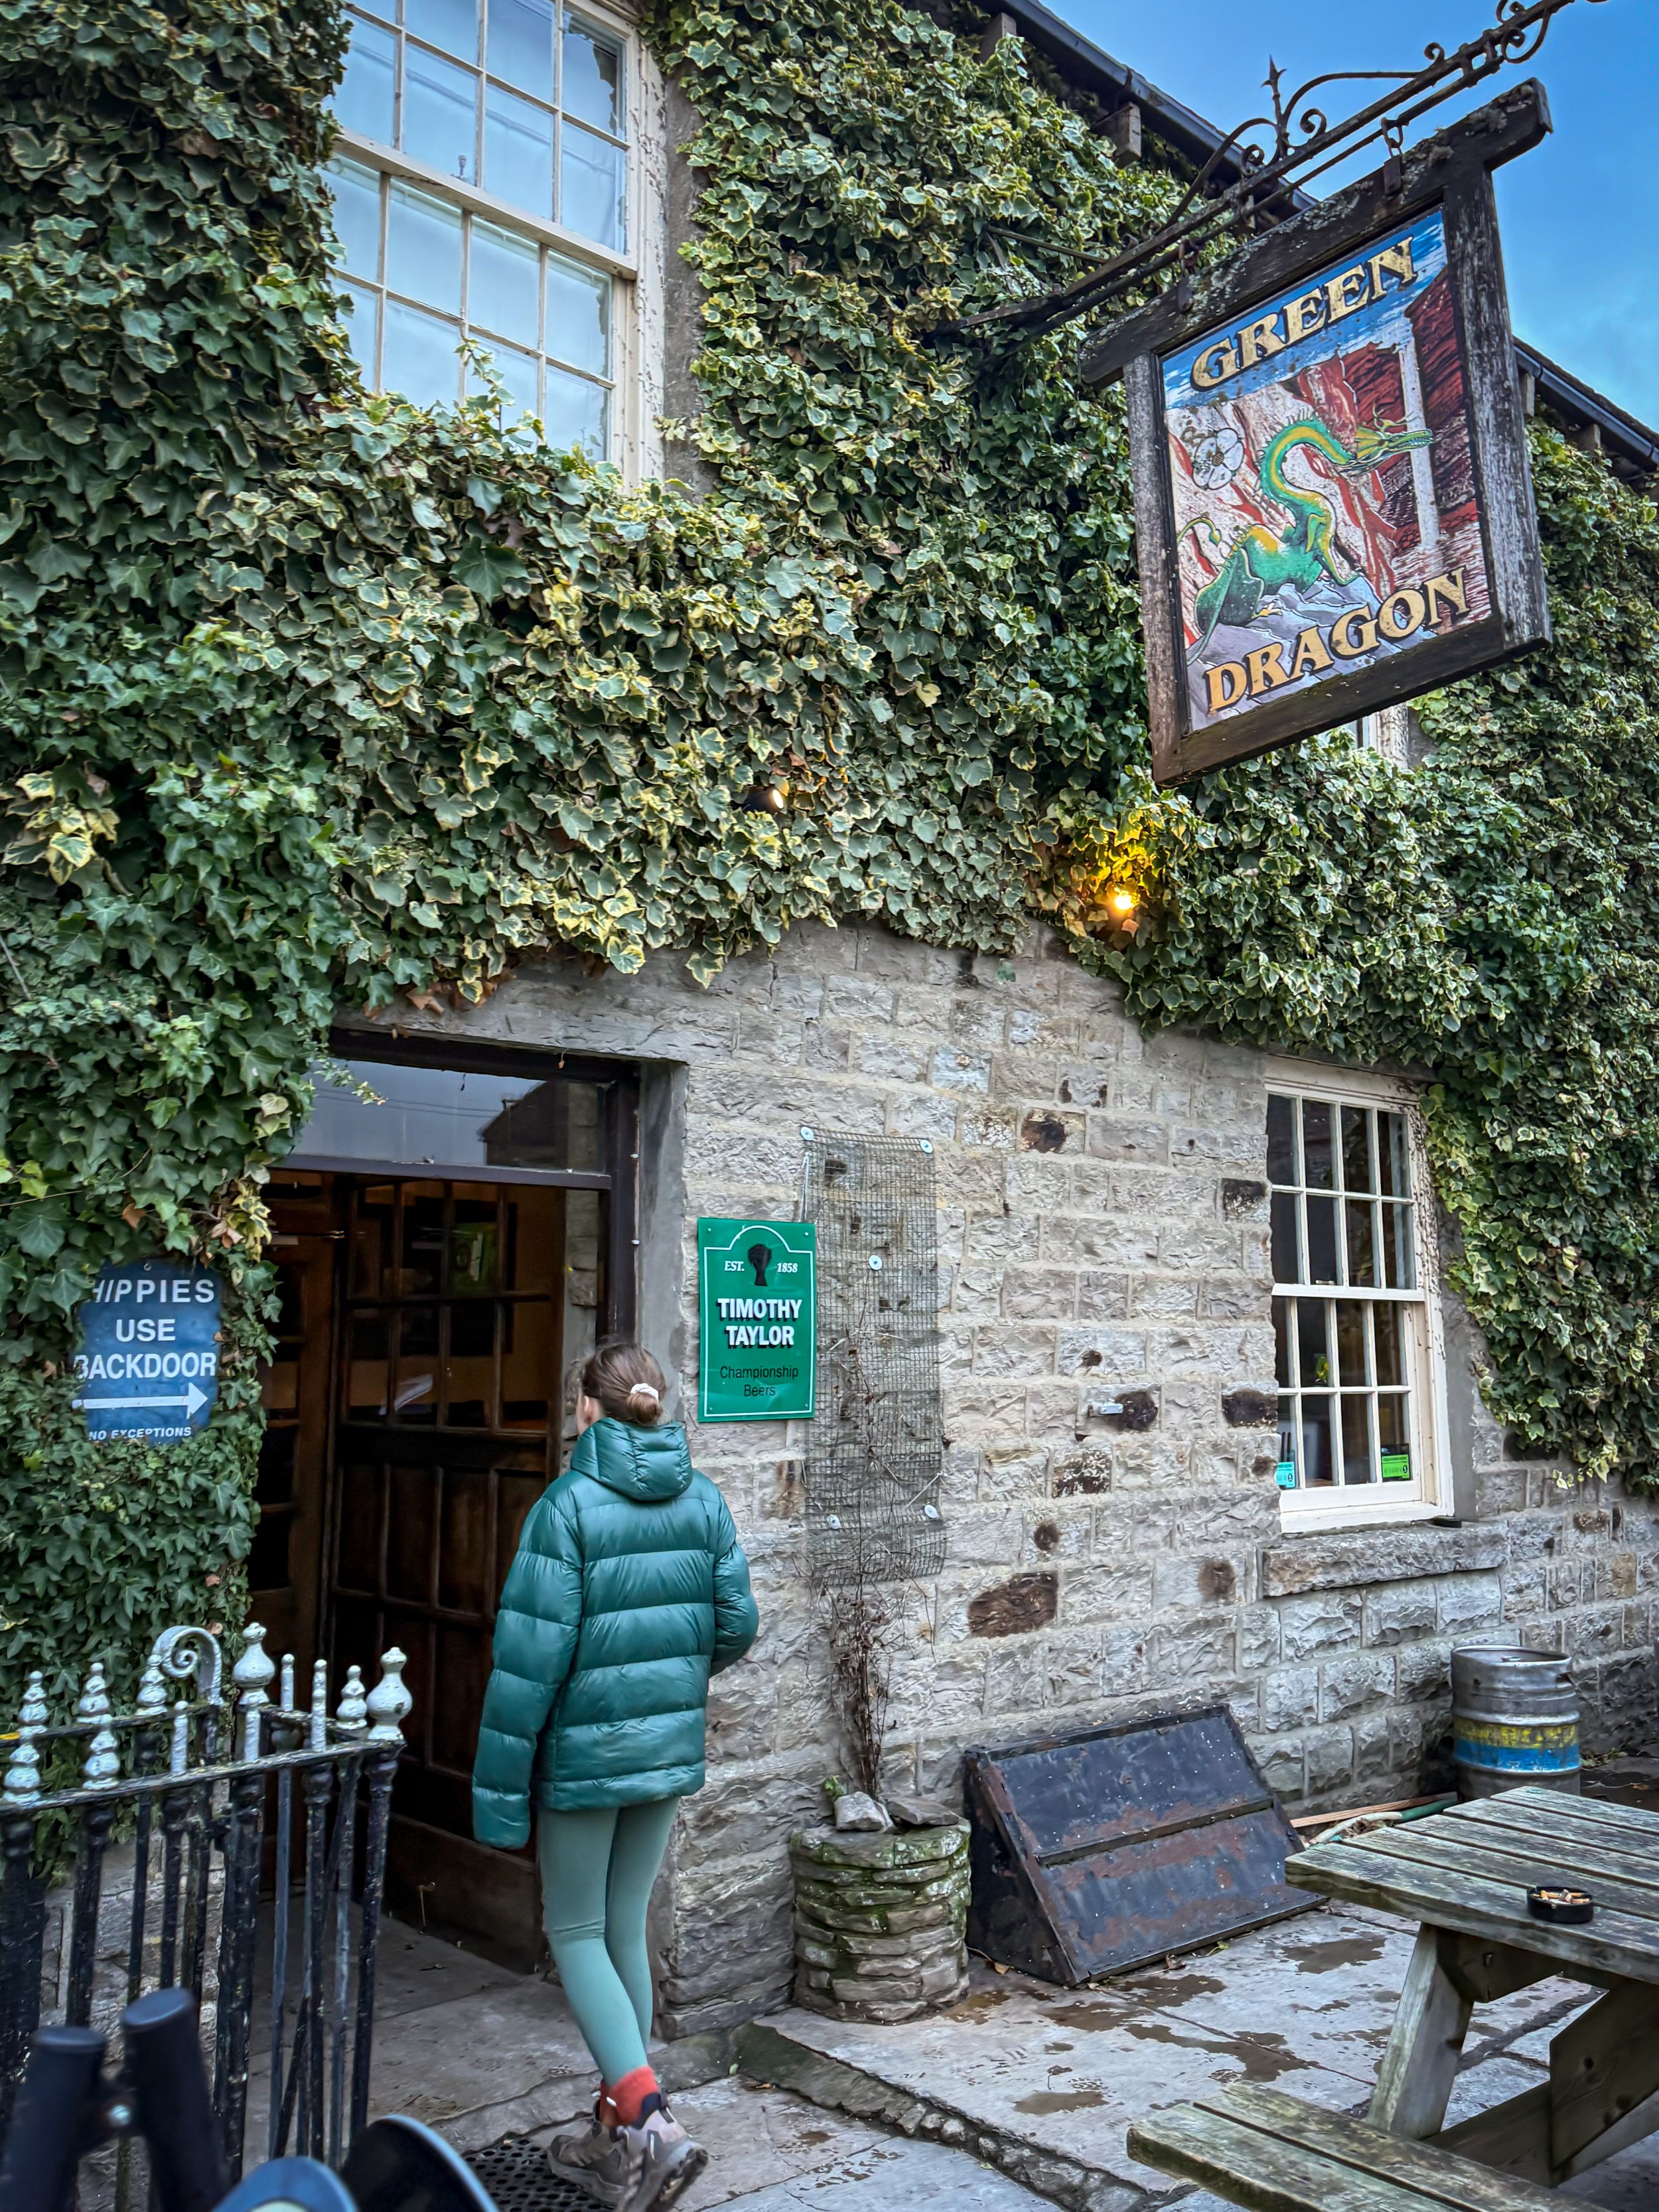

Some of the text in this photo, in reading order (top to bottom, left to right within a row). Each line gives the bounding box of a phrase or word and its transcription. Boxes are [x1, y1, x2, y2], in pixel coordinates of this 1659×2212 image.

[1191, 236, 1417, 391] GREEN
[1204, 567, 1471, 711] DRAGON
[724, 1261, 798, 1273] EST. 1858
[717, 1298, 802, 1320] TIMOTHY
[115, 1319, 176, 1342] USE
[725, 1325, 795, 1347] TAYLOR
[73, 1352, 217, 1379] BACKDOOR
[719, 1365, 799, 1380] Championship
[743, 1384, 776, 1396] Beers
[88, 1430, 107, 1440] NO
